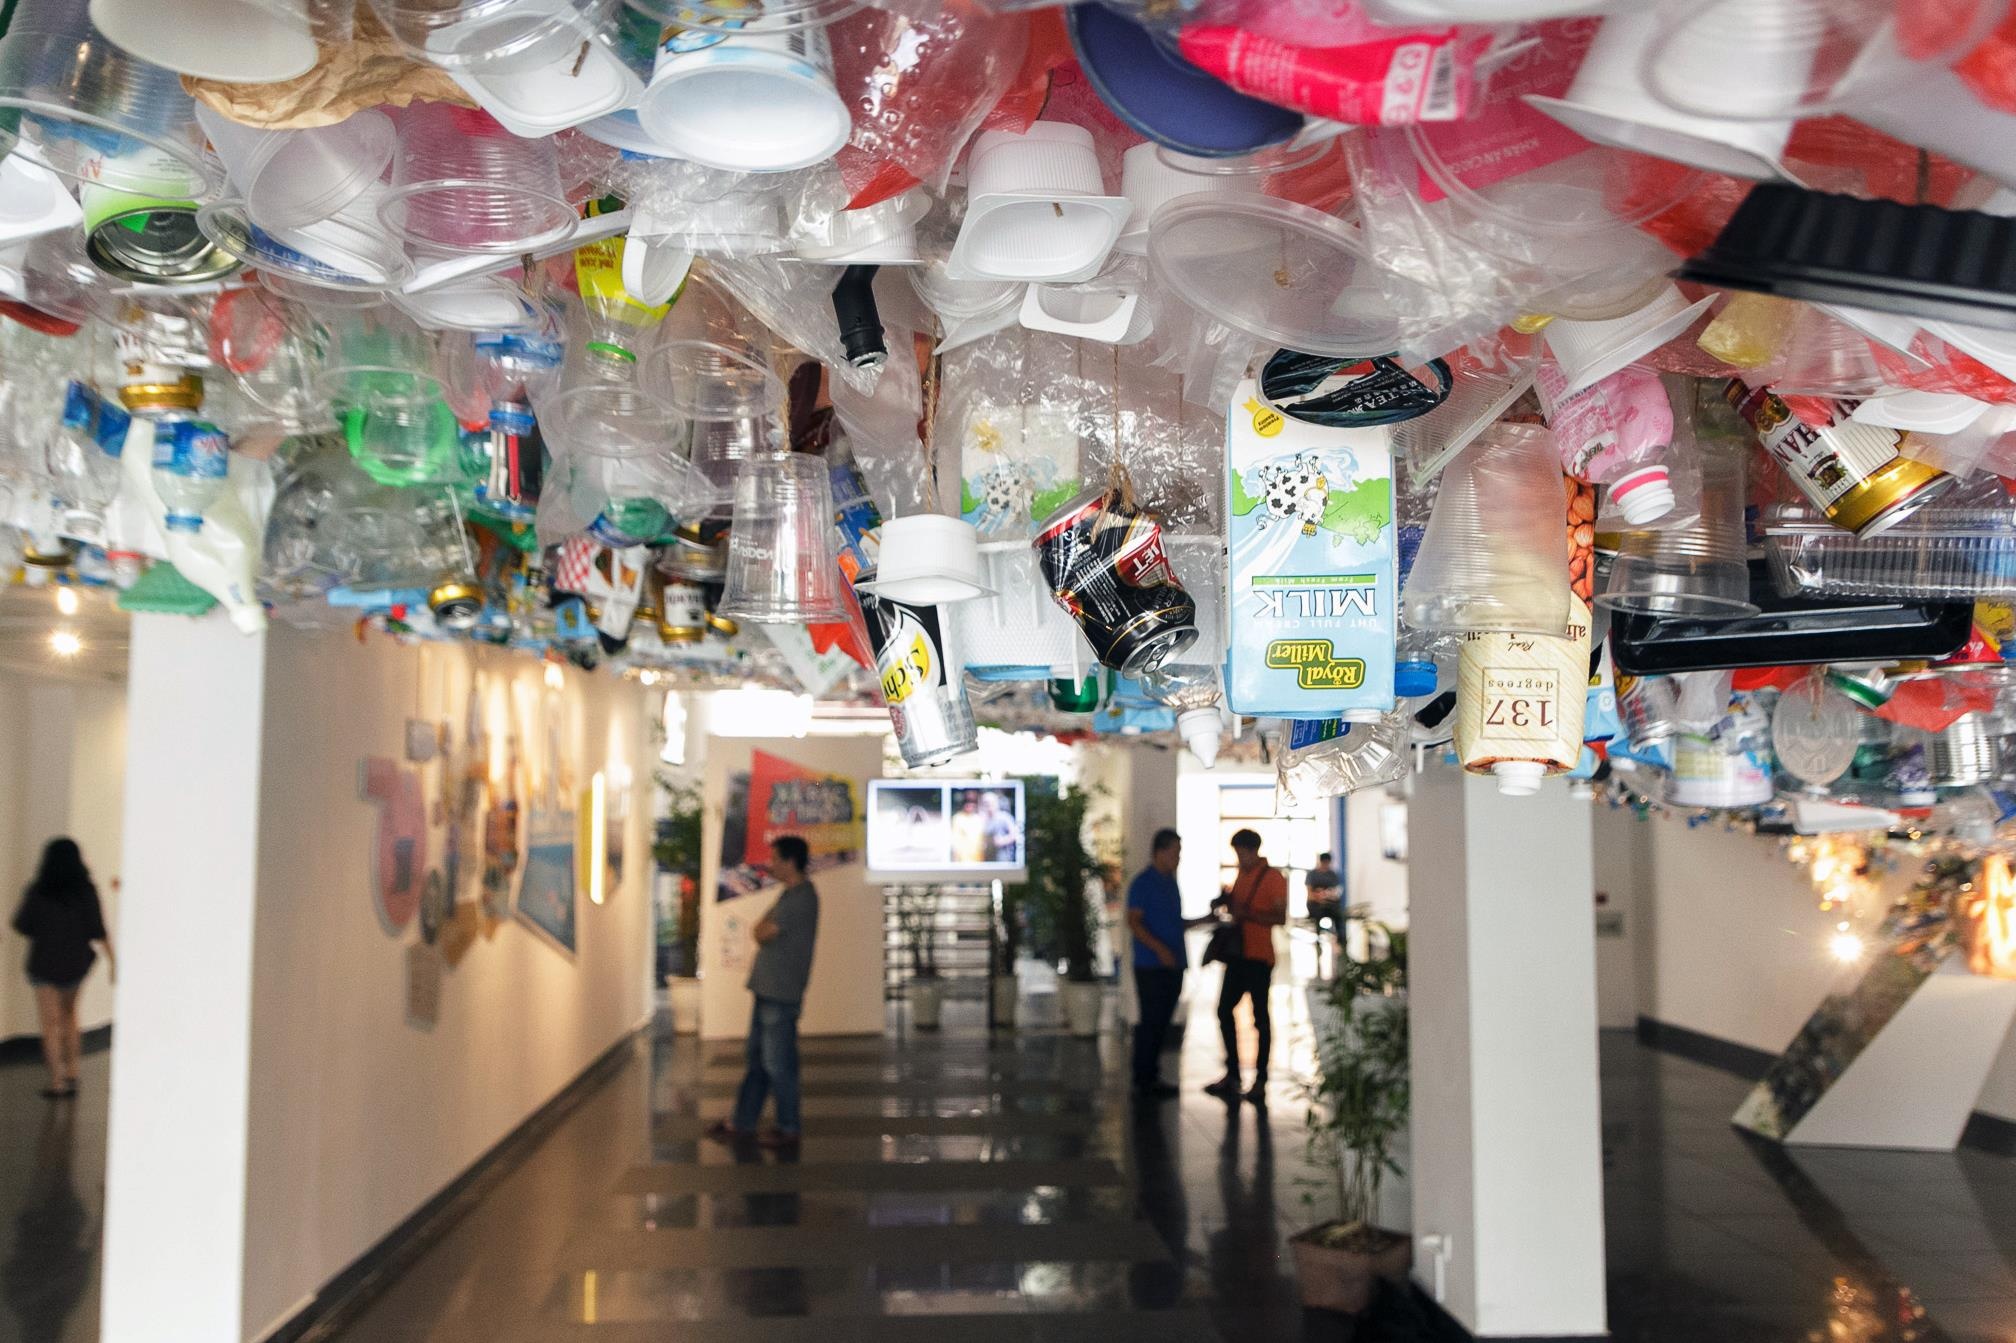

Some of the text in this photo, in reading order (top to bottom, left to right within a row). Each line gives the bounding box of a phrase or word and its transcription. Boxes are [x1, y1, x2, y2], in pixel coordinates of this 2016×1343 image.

[1364, 391, 1399, 409] TEA
[1252, 588, 1378, 618] MILK
[1271, 644, 1327, 663] Miller
[1508, 641, 1535, 652] Real
[1306, 661, 1357, 685] Royal
[1488, 679, 1553, 692] degrees
[1486, 699, 1553, 727] 137
